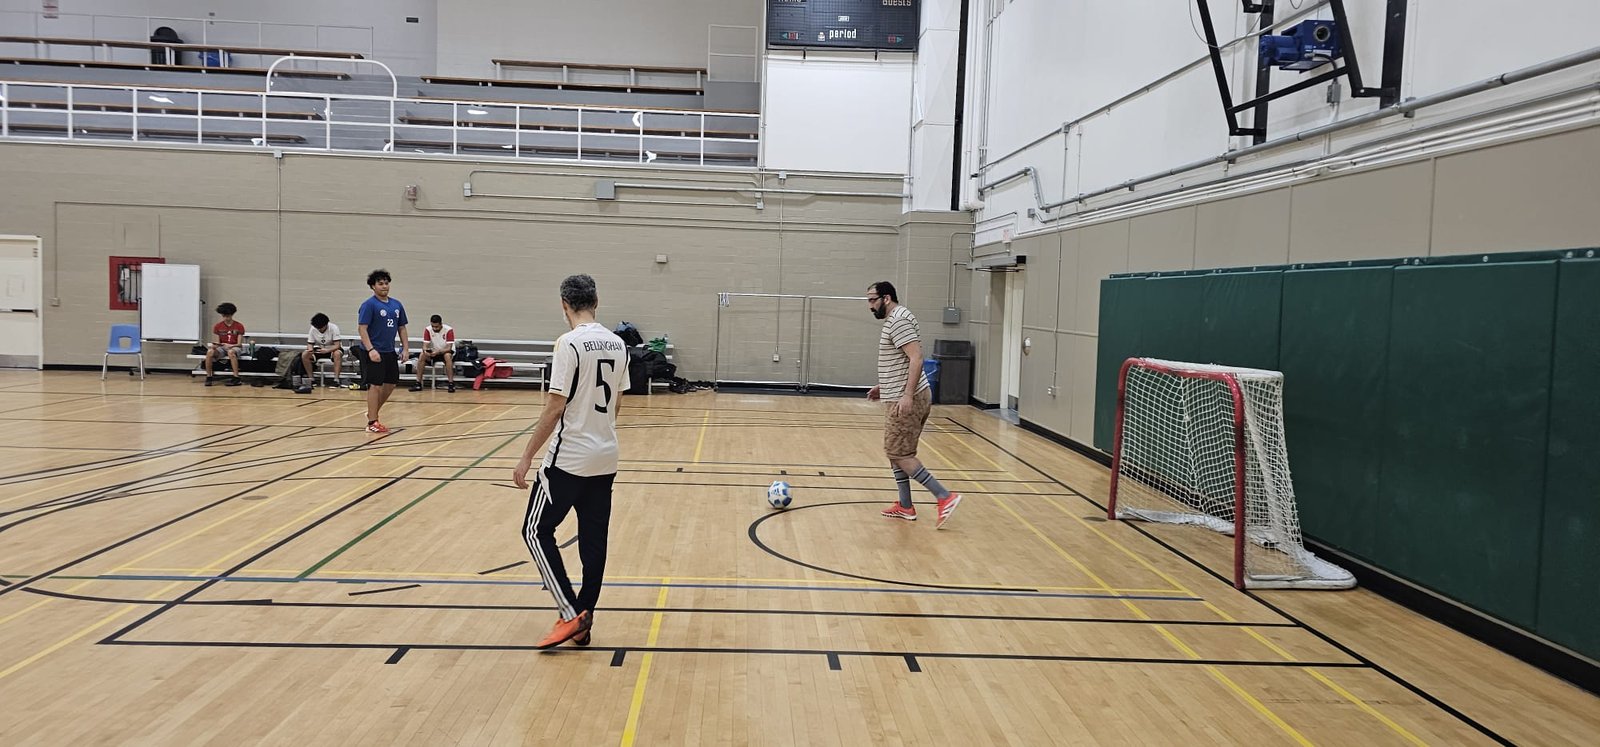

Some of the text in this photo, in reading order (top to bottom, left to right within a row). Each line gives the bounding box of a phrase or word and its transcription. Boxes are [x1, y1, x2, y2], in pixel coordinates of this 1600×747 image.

[829, 29, 857, 39] period
[387, 318, 394, 328] 22
[595, 359, 615, 413] 5
